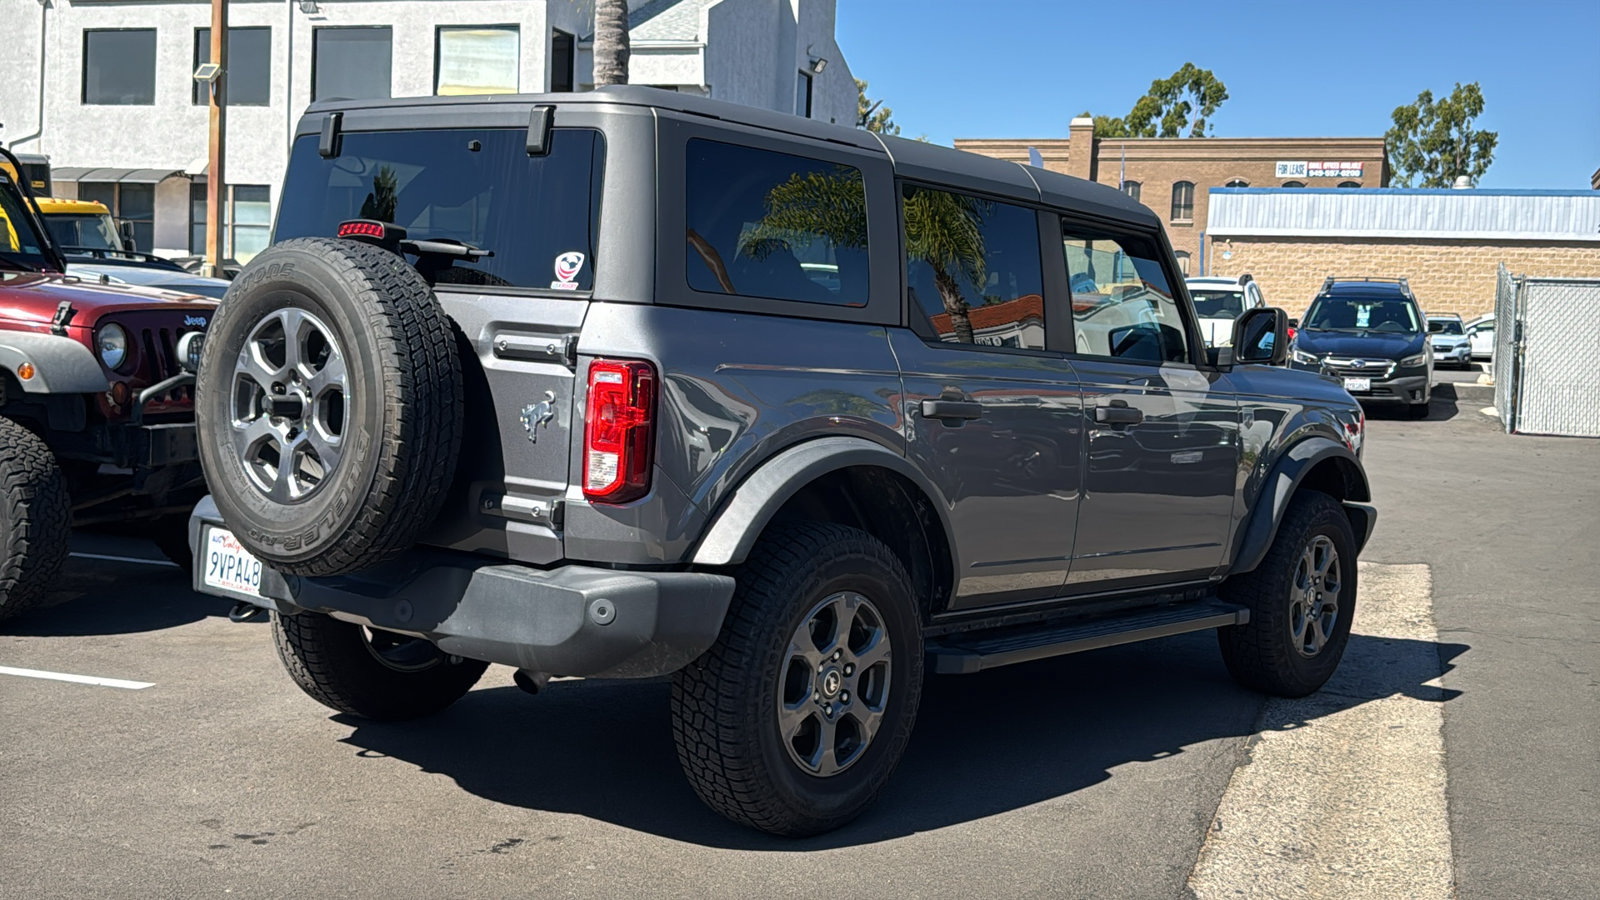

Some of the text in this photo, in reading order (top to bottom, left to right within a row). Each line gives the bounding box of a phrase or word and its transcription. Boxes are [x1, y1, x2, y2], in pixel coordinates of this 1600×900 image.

[1278, 164, 1288, 175] FOR
[1289, 163, 1305, 175] LEASE
[184, 314, 207, 328] Jeep
[210, 551, 261, 587] 9VPA48
